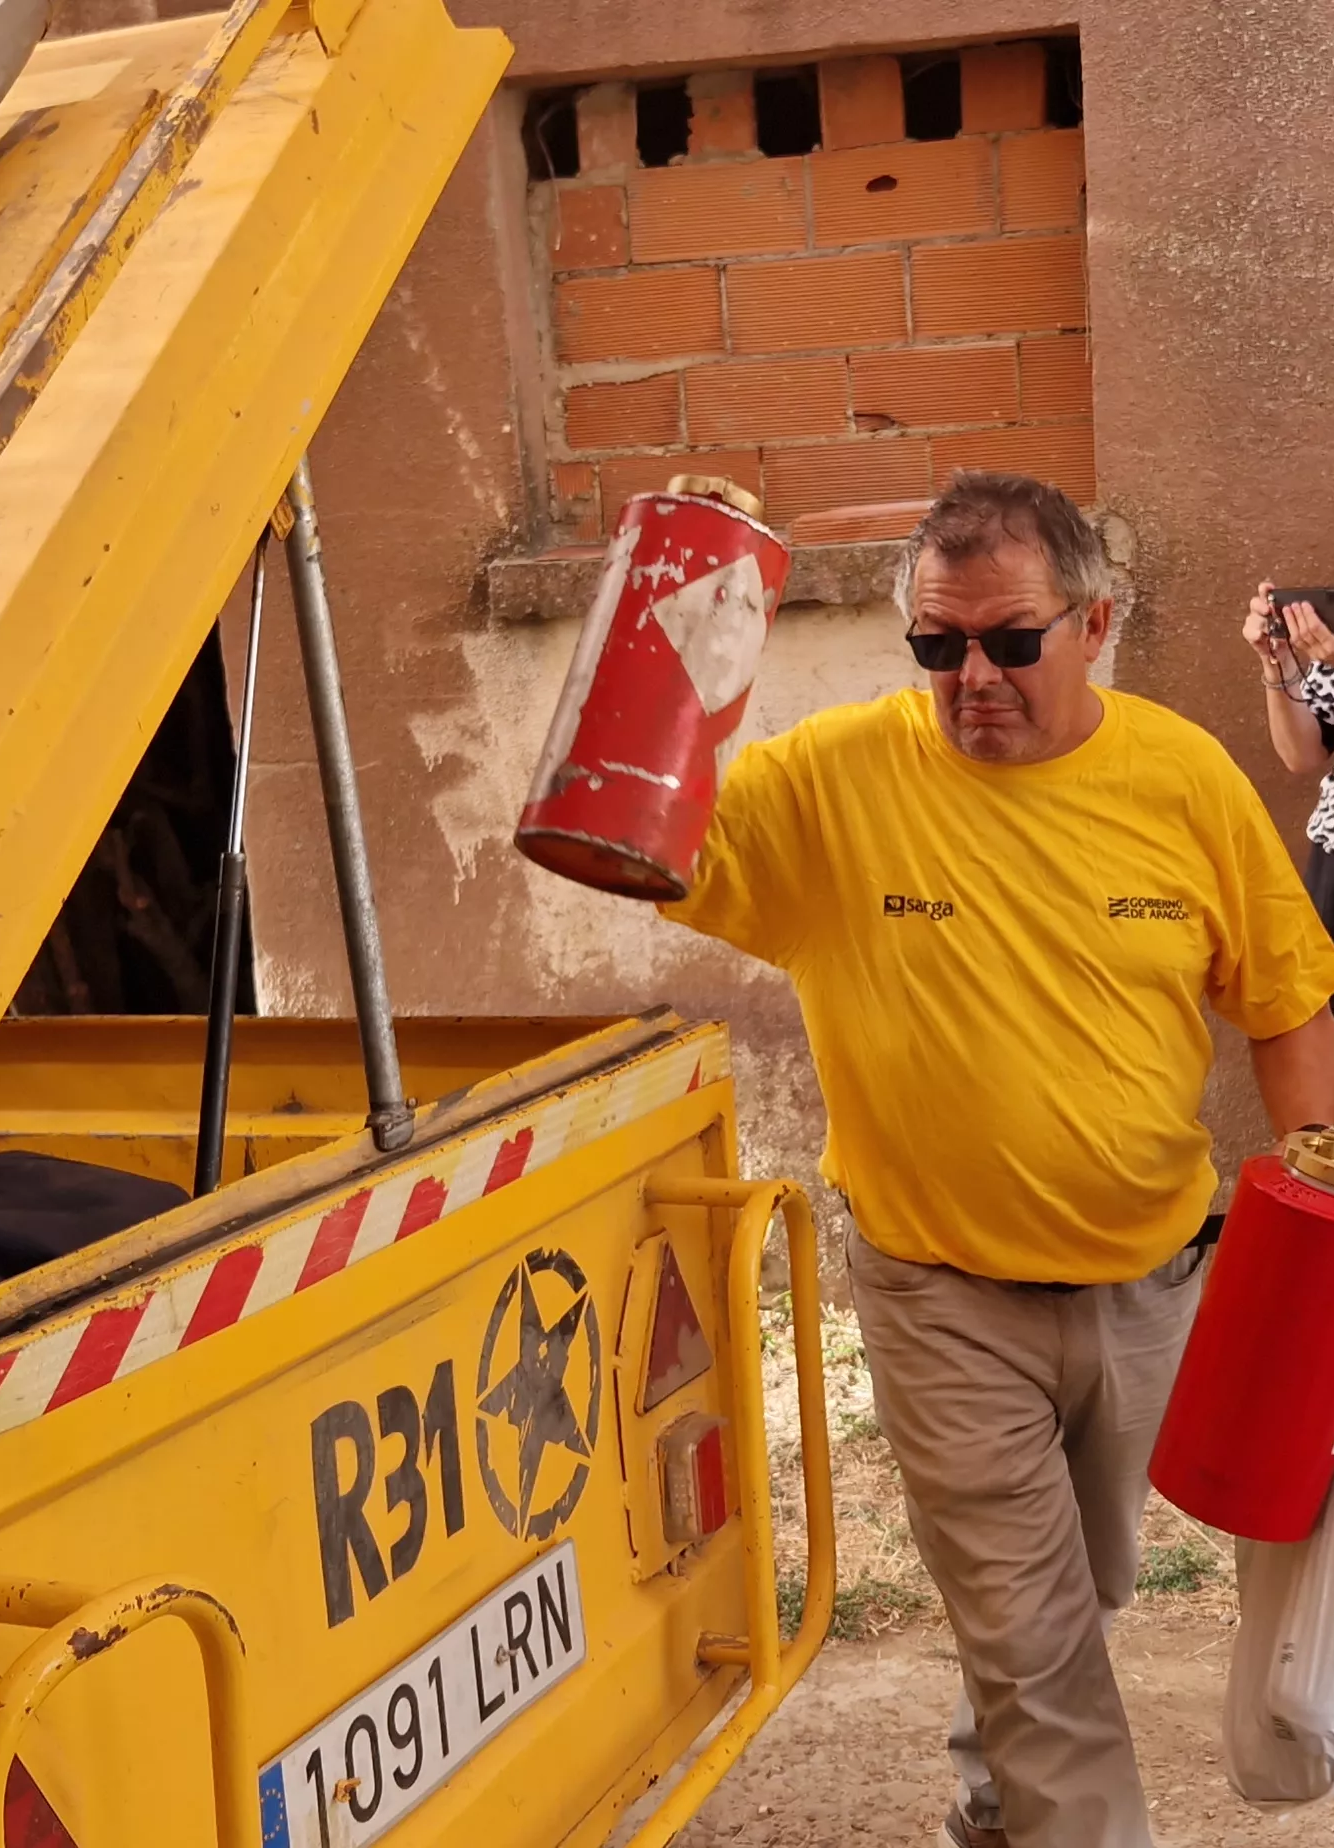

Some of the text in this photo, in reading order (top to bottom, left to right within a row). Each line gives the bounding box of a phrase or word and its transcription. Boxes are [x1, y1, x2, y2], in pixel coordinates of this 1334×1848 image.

[906, 897, 954, 921] sarga
[1129, 896, 1183, 910] GOBIERNO
[1130, 908, 1146, 920] DE
[311, 1359, 466, 1629] R31
[305, 1560, 574, 1848] 1091 LRN
